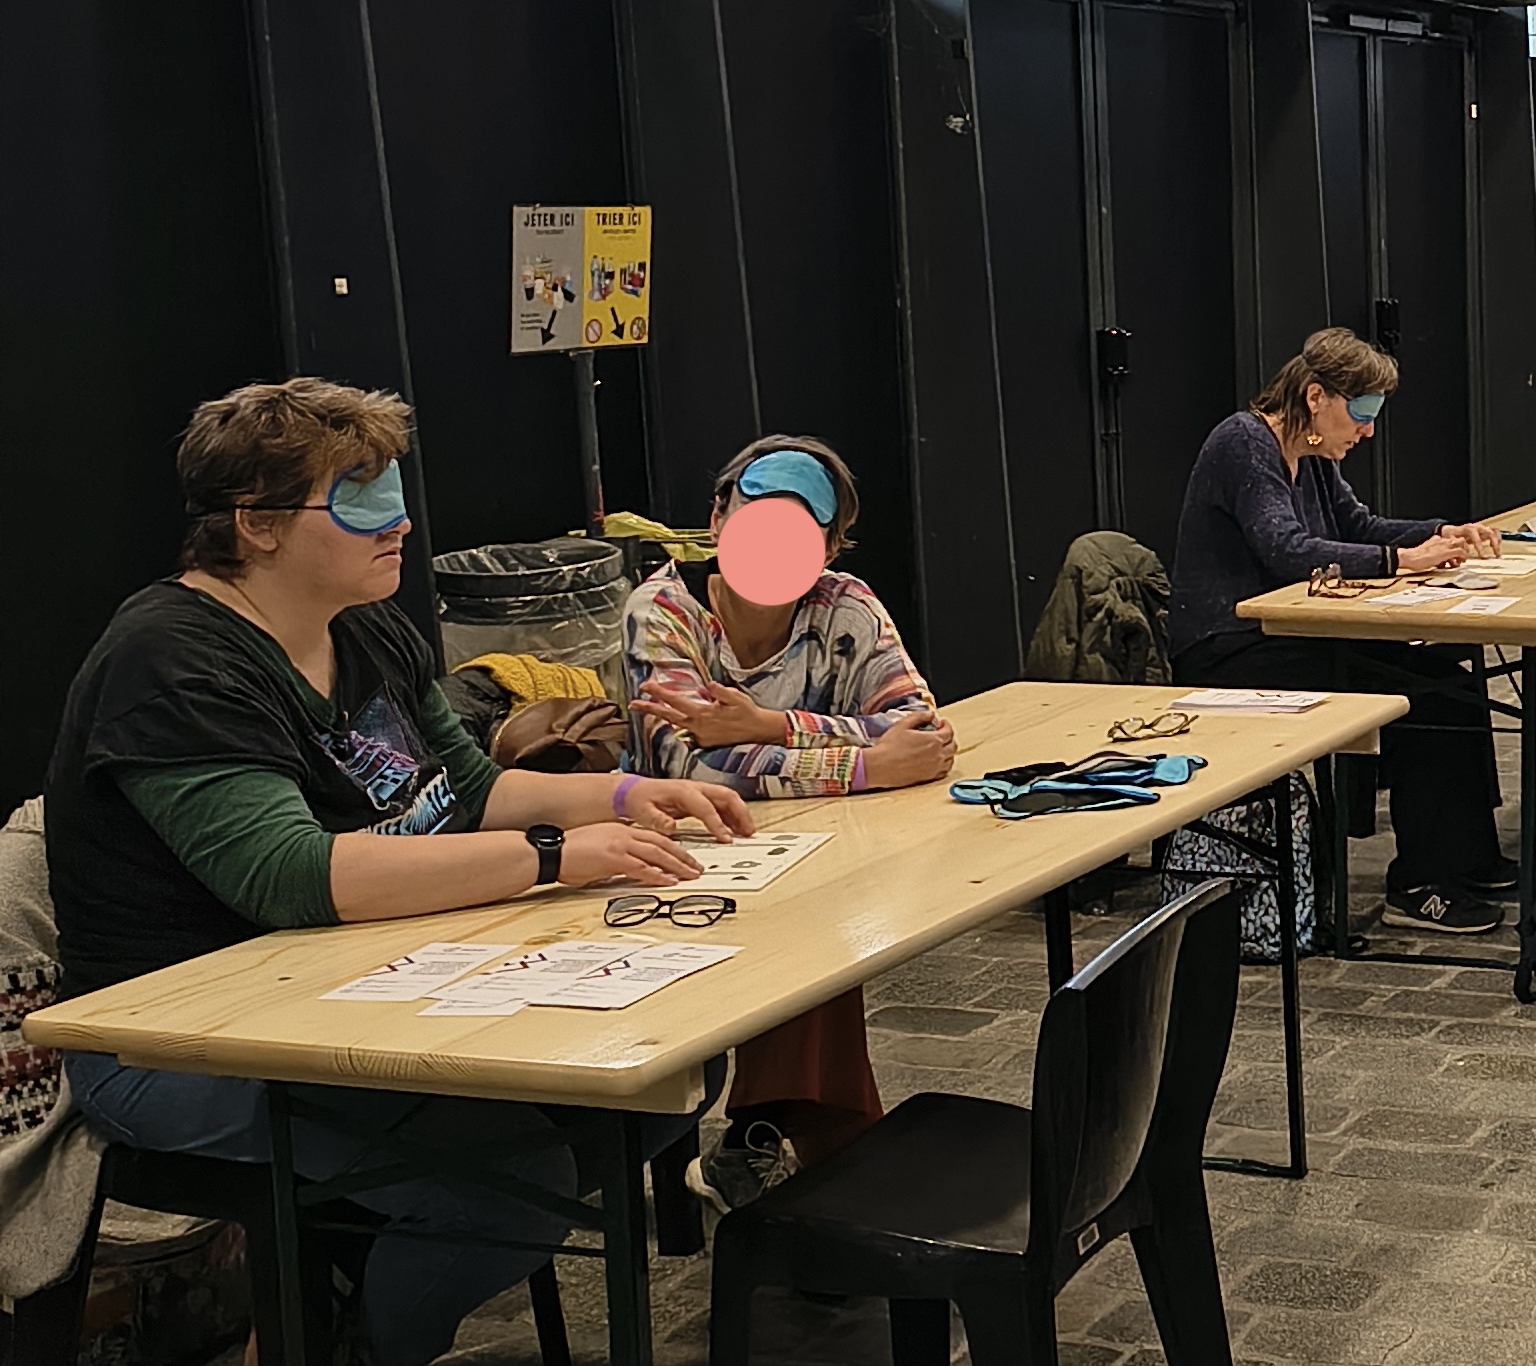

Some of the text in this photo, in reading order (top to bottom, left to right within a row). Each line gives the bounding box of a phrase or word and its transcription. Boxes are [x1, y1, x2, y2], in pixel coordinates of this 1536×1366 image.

[524, 212, 575, 227] JETER ICI
[596, 212, 642, 226] TRIER ICI
